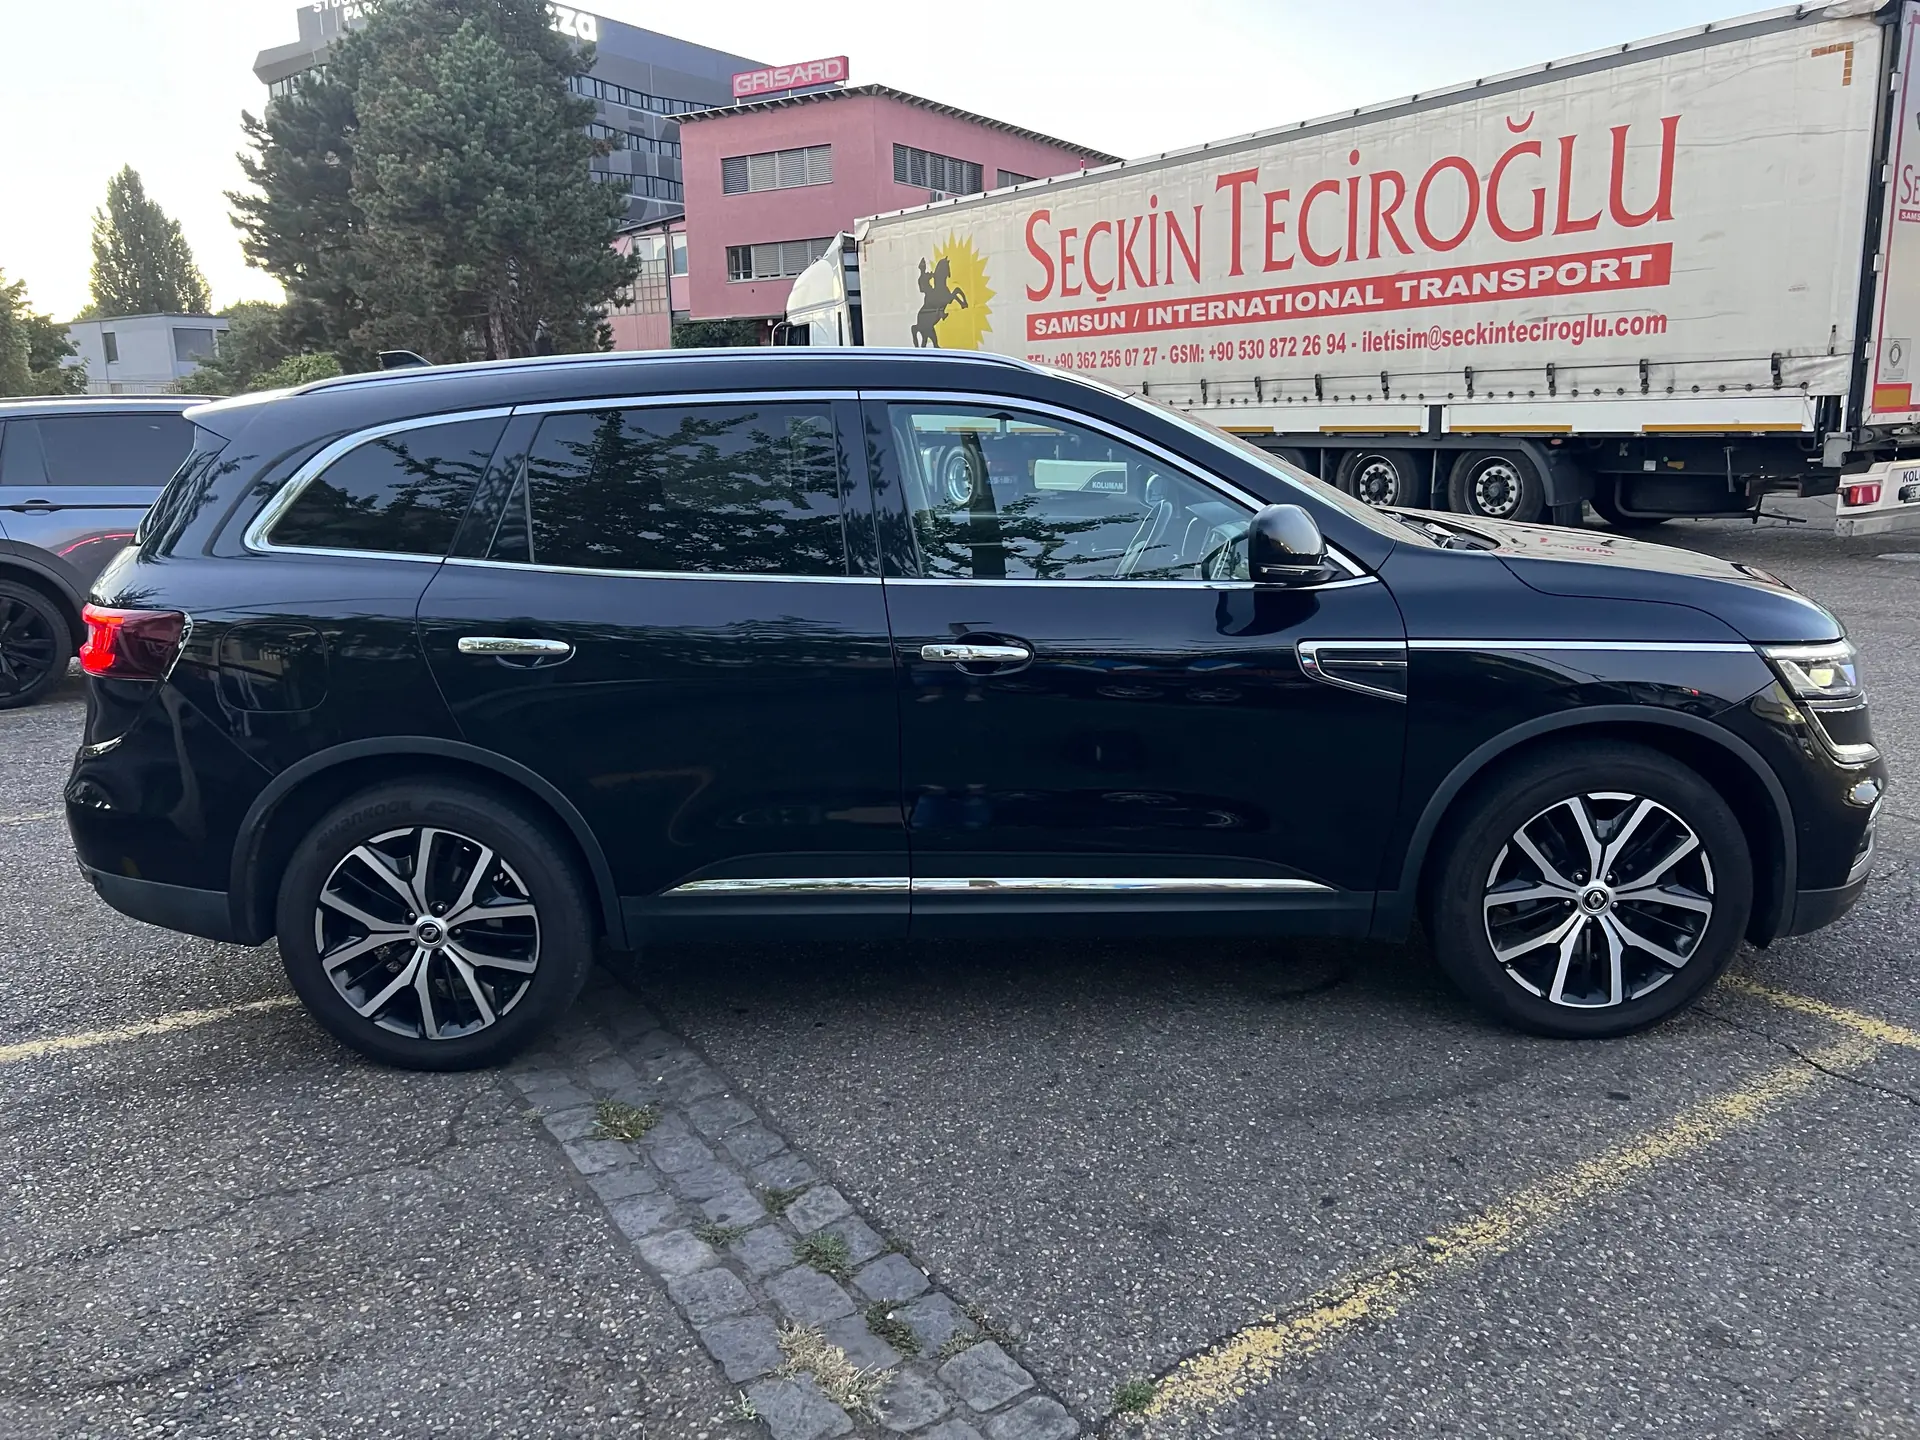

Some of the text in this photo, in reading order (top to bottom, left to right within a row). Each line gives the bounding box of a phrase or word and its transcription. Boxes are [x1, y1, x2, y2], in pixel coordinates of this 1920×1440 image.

[735, 59, 842, 93] GRISARD
[1026, 111, 1681, 303] SEÇKİN TECİROĞLU
[1035, 254, 1652, 335] SAMSUN / INTERNATIONAL TRANSPORT
[1054, 352, 1073, 369] +90
[1077, 352, 1097, 369] 362
[1100, 350, 1121, 368] 256
[1125, 348, 1139, 366] 07
[1143, 347, 1158, 366] 27
[1170, 344, 1204, 364] GSM:
[1209, 341, 1234, 361] +90
[1239, 339, 1265, 360] 530
[1269, 336, 1297, 358] 872
[1302, 334, 1321, 356] 26
[1326, 332, 1347, 354] 94
[1362, 314, 1667, 352] iletisim@seckinteciroglu.com
[1092, 481, 1124, 490] KOLUMAN
